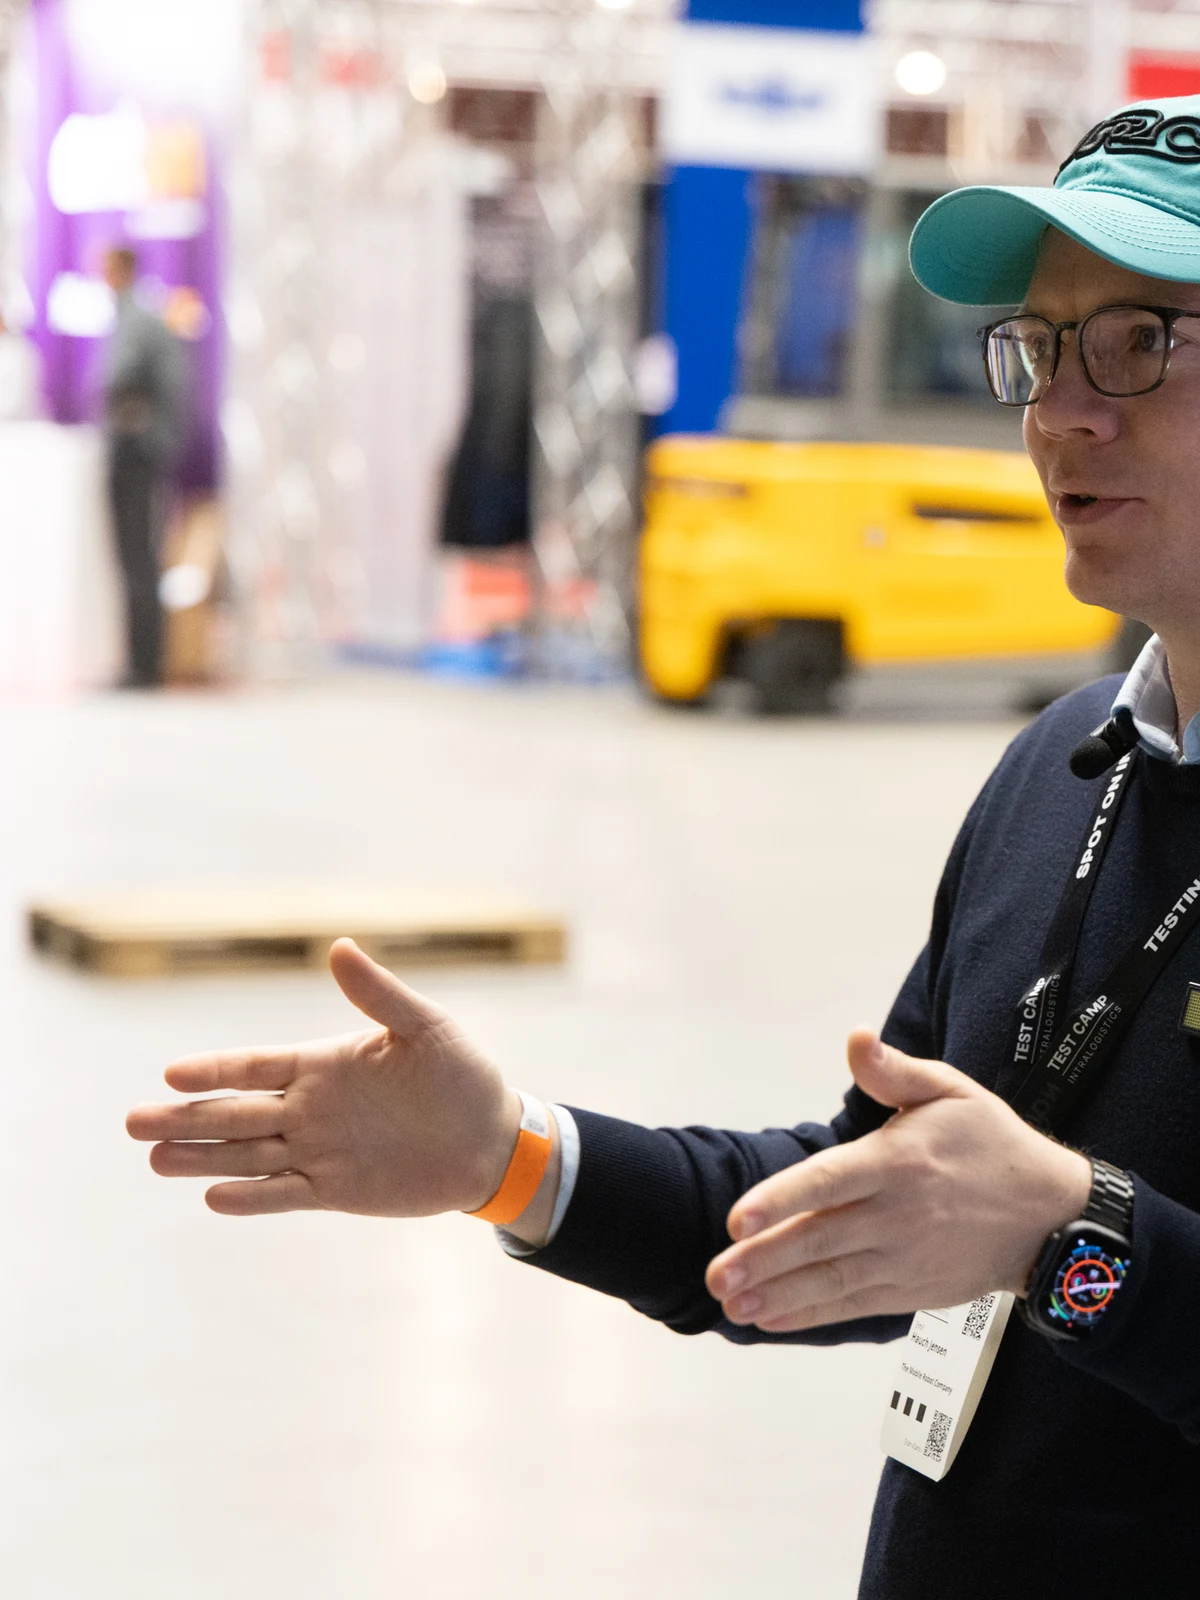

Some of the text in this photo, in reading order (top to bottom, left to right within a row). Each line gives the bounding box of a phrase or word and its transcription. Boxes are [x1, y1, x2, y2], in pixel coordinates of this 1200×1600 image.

[1075, 815, 1107, 879] SPOT
[1101, 774, 1124, 809] ON
[1014, 977, 1046, 1062] TEST CAMP
[1040, 973, 1061, 1058] TRALOGISTICS
[1047, 1033, 1077, 1071] TEST
[1072, 994, 1108, 1035] CAMP
[1067, 1005, 1122, 1084] INTRALOGISTICS
